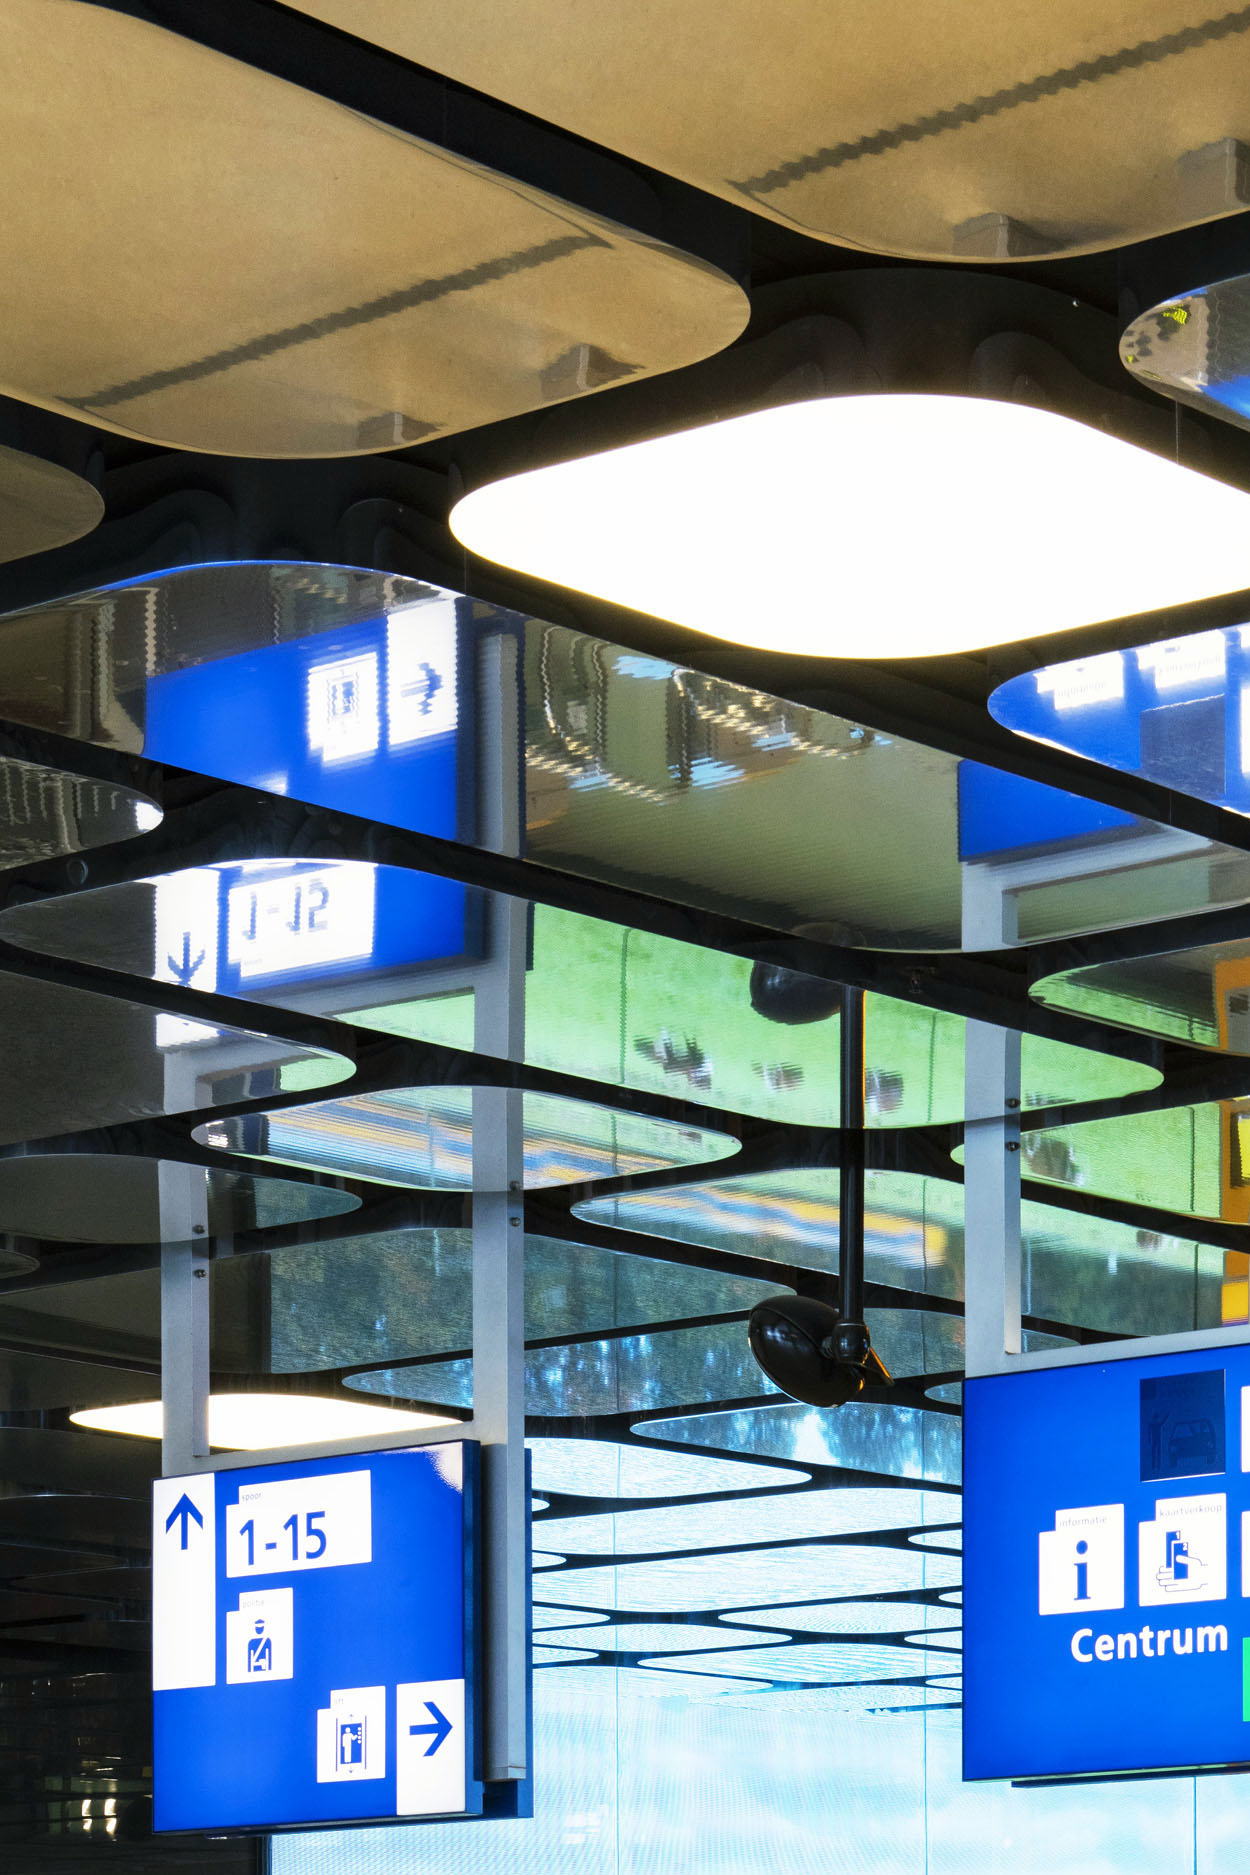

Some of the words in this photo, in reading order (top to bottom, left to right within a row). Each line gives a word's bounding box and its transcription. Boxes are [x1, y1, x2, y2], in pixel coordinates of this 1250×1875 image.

[1059, 1515, 1107, 1528] informatie
[1159, 1503, 1223, 1518] kaartverkoop
[239, 1511, 326, 1565] 1-15
[1071, 1624, 1228, 1663] Centrum
